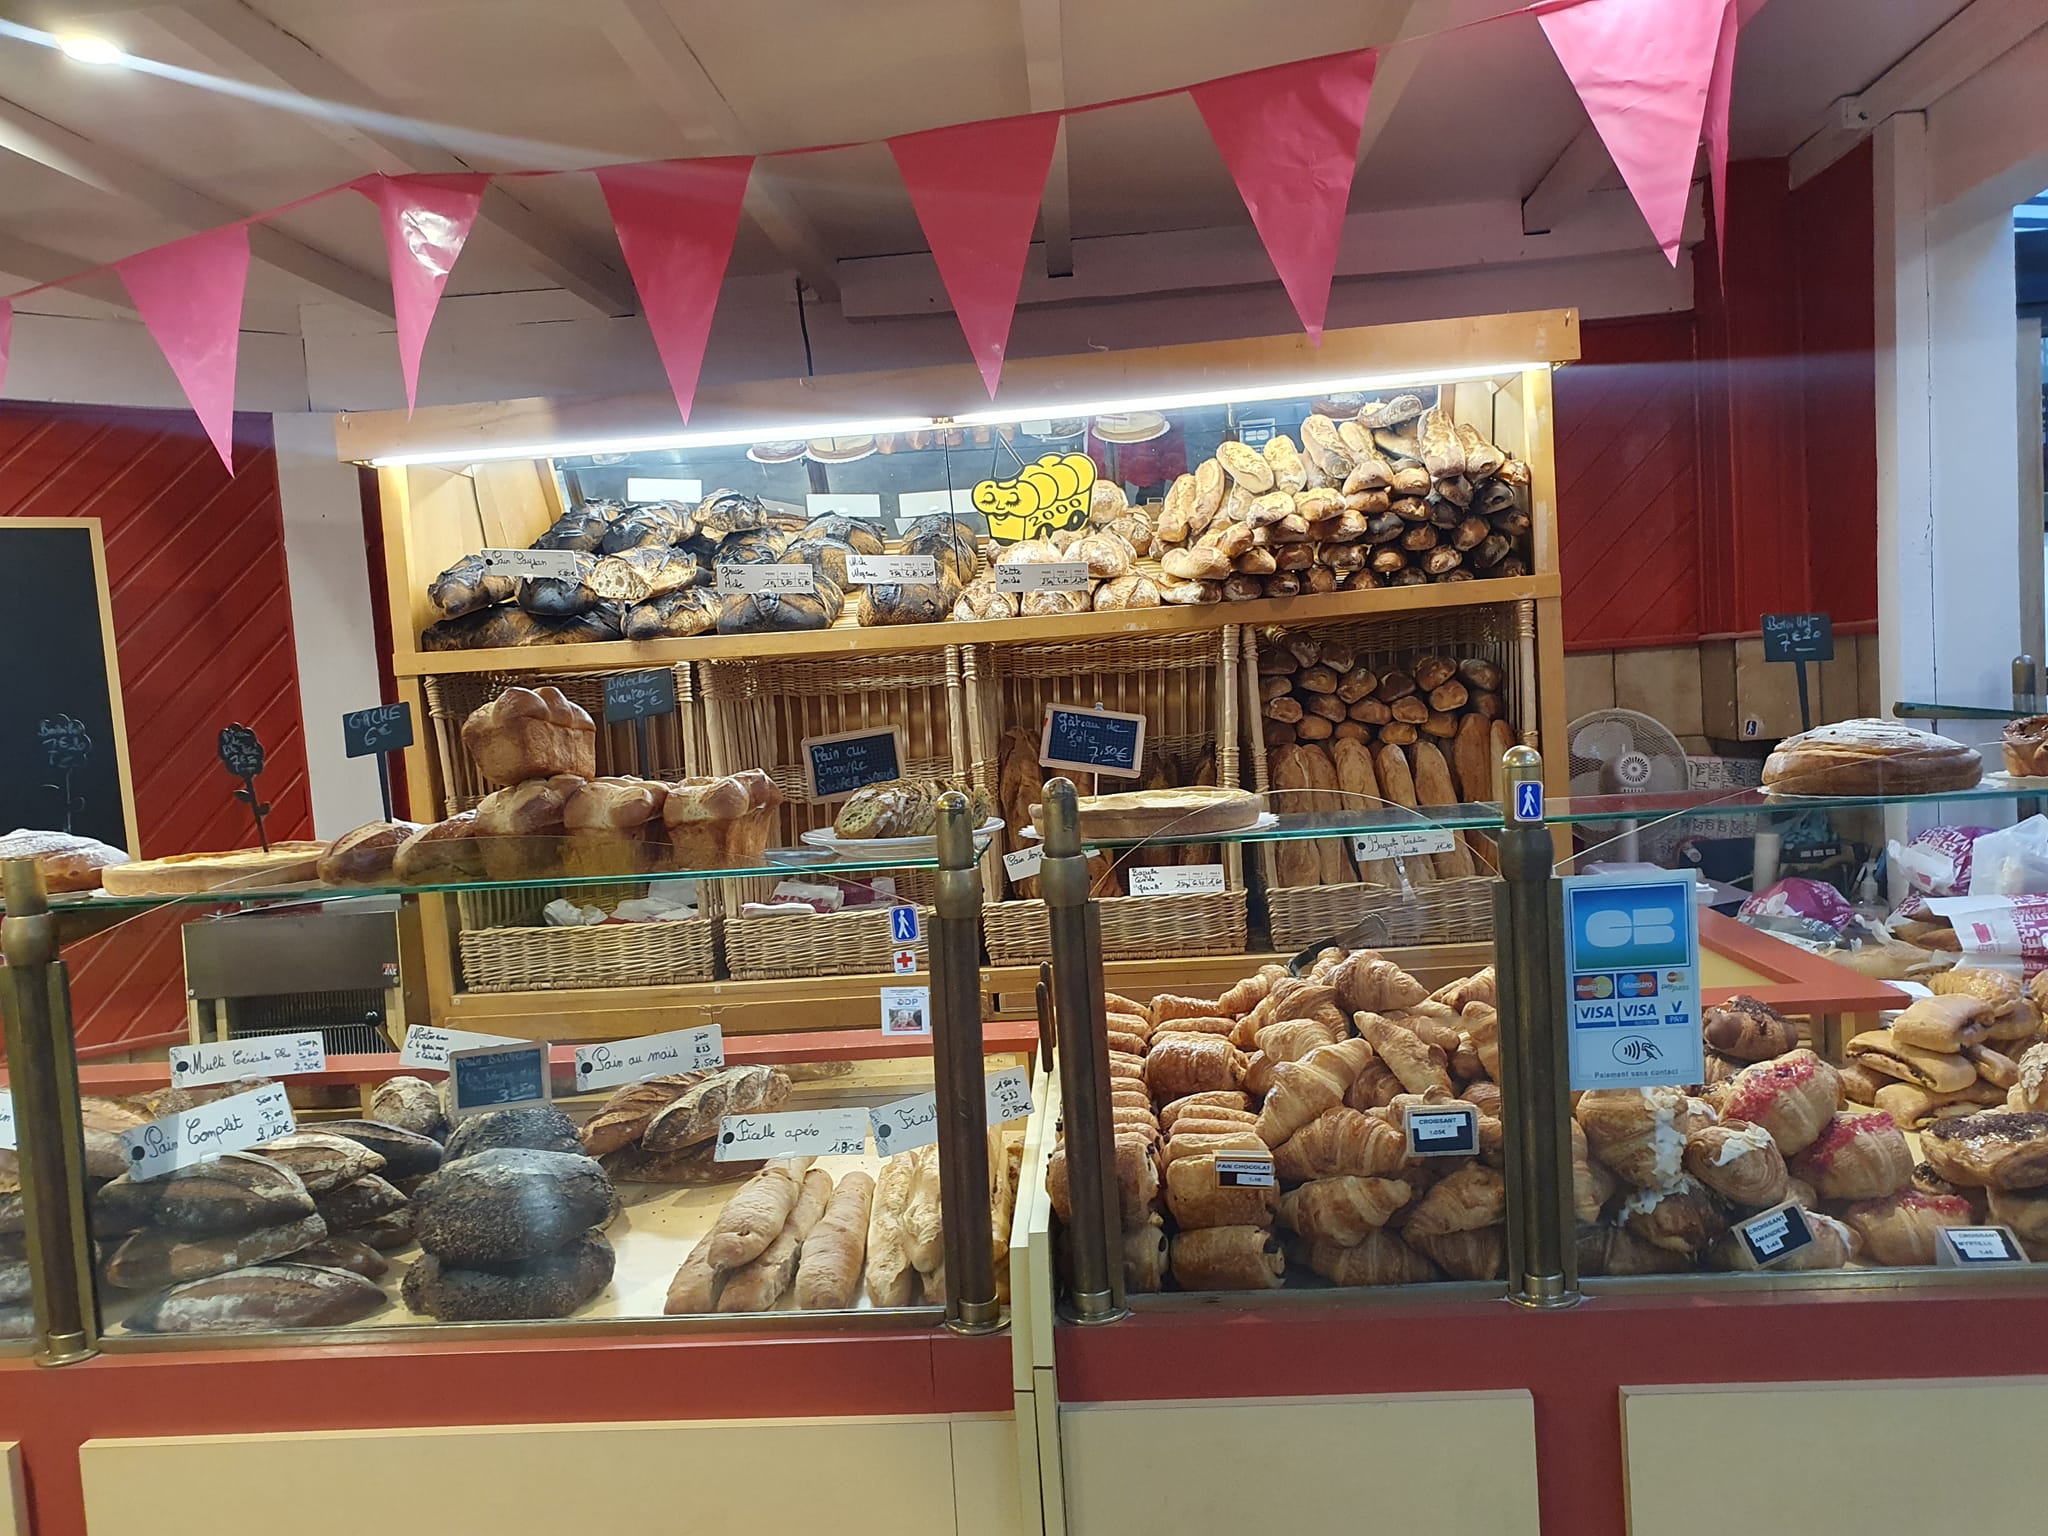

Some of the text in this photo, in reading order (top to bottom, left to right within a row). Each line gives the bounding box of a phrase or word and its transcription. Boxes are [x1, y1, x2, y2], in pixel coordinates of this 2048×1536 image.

[1028, 498, 1082, 527] 2000
[492, 551, 511, 566] Pain
[1107, 721, 1128, 733] de
[811, 746, 840, 763] Pain
[1007, 853, 1025, 867] Pain
[1585, 906, 1676, 948] CB
[1581, 1006, 1614, 1018] VISA
[1623, 1003, 1657, 1017] VISA
[592, 1045, 679, 1072] Pain au maïs
[1418, 1117, 1457, 1125] CROISSANT
[145, 1113, 243, 1158] Pain Complet
[736, 1119, 776, 1142] Ficelle
[1233, 1163, 1270, 1171] CHOCOLAT
[1748, 1215, 1785, 1235] CROISSANT
[1755, 1226, 1786, 1244] AMANDES
